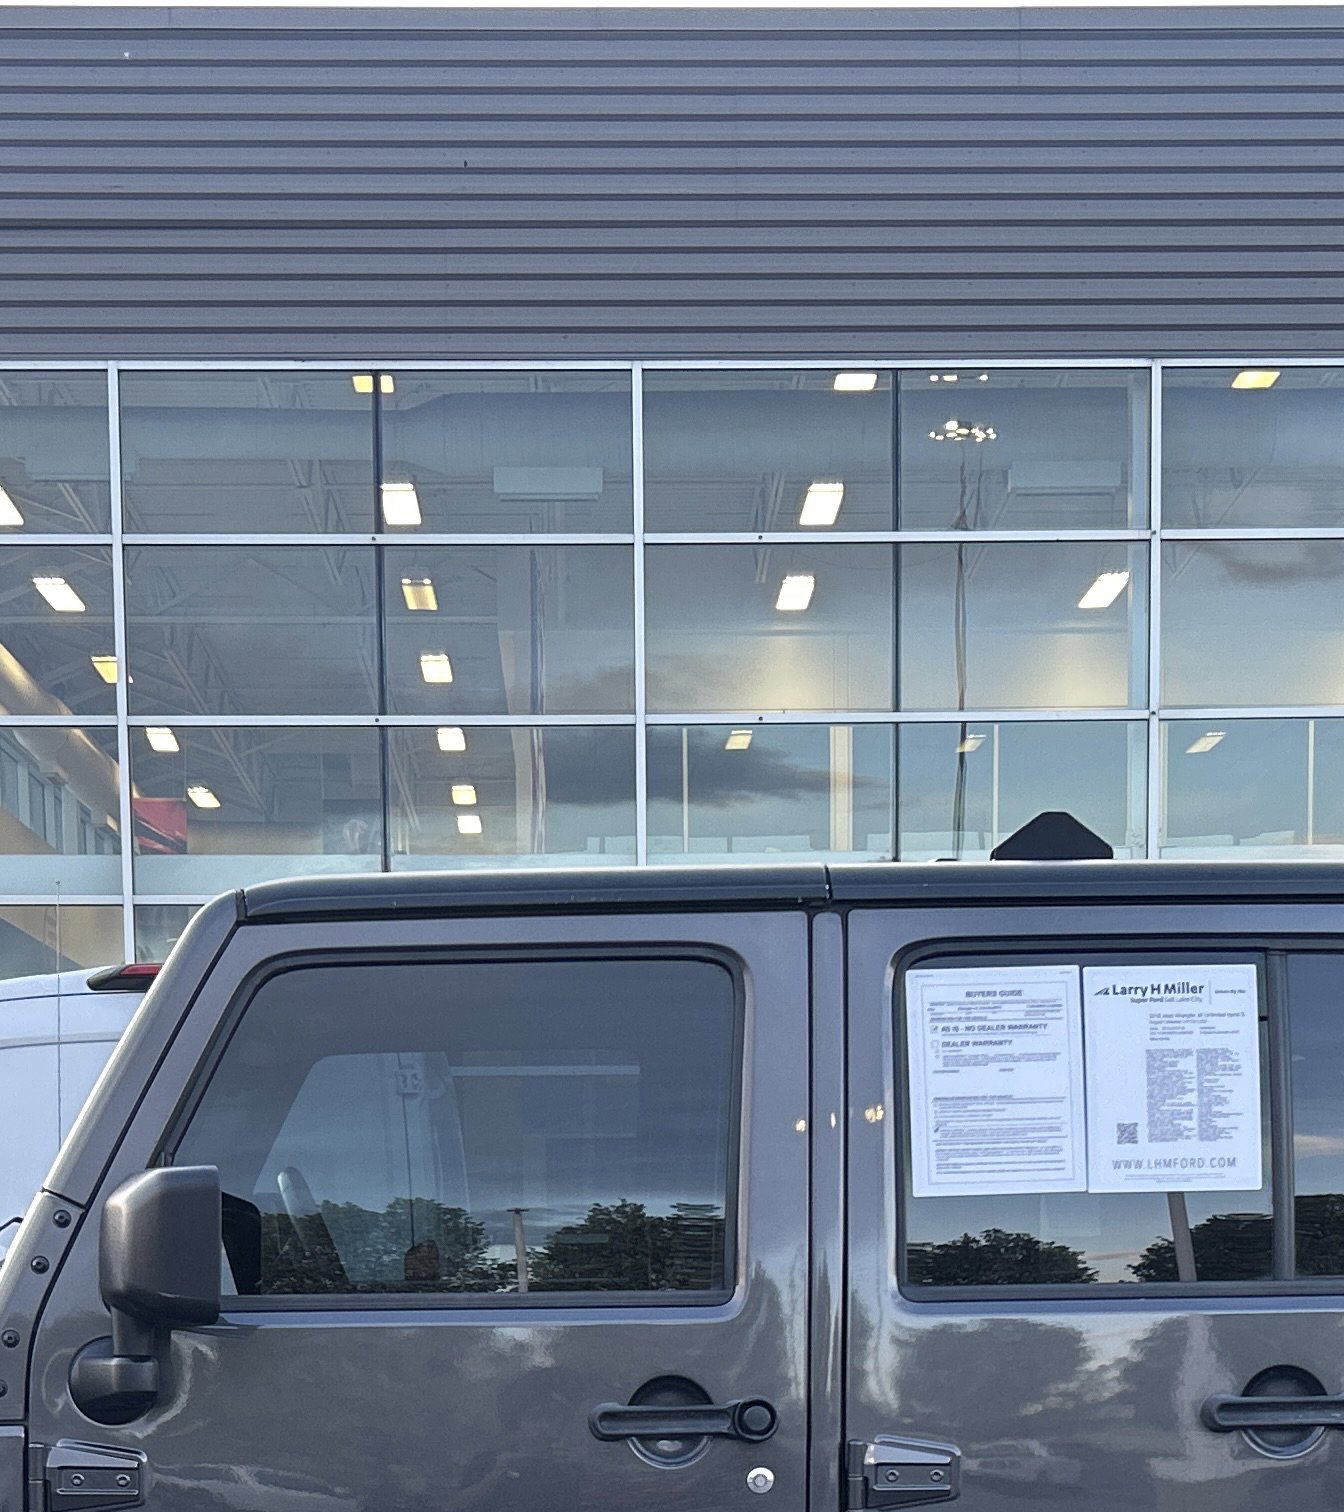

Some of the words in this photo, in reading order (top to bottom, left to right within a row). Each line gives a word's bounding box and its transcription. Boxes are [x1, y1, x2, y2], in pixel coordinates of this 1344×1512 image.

[1112, 984, 1148, 997] Larry
[1151, 984, 1161, 994] H
[1164, 982, 1204, 994] Miller
[1112, 1157, 1236, 1170] WWW.LHMFORD.COM
